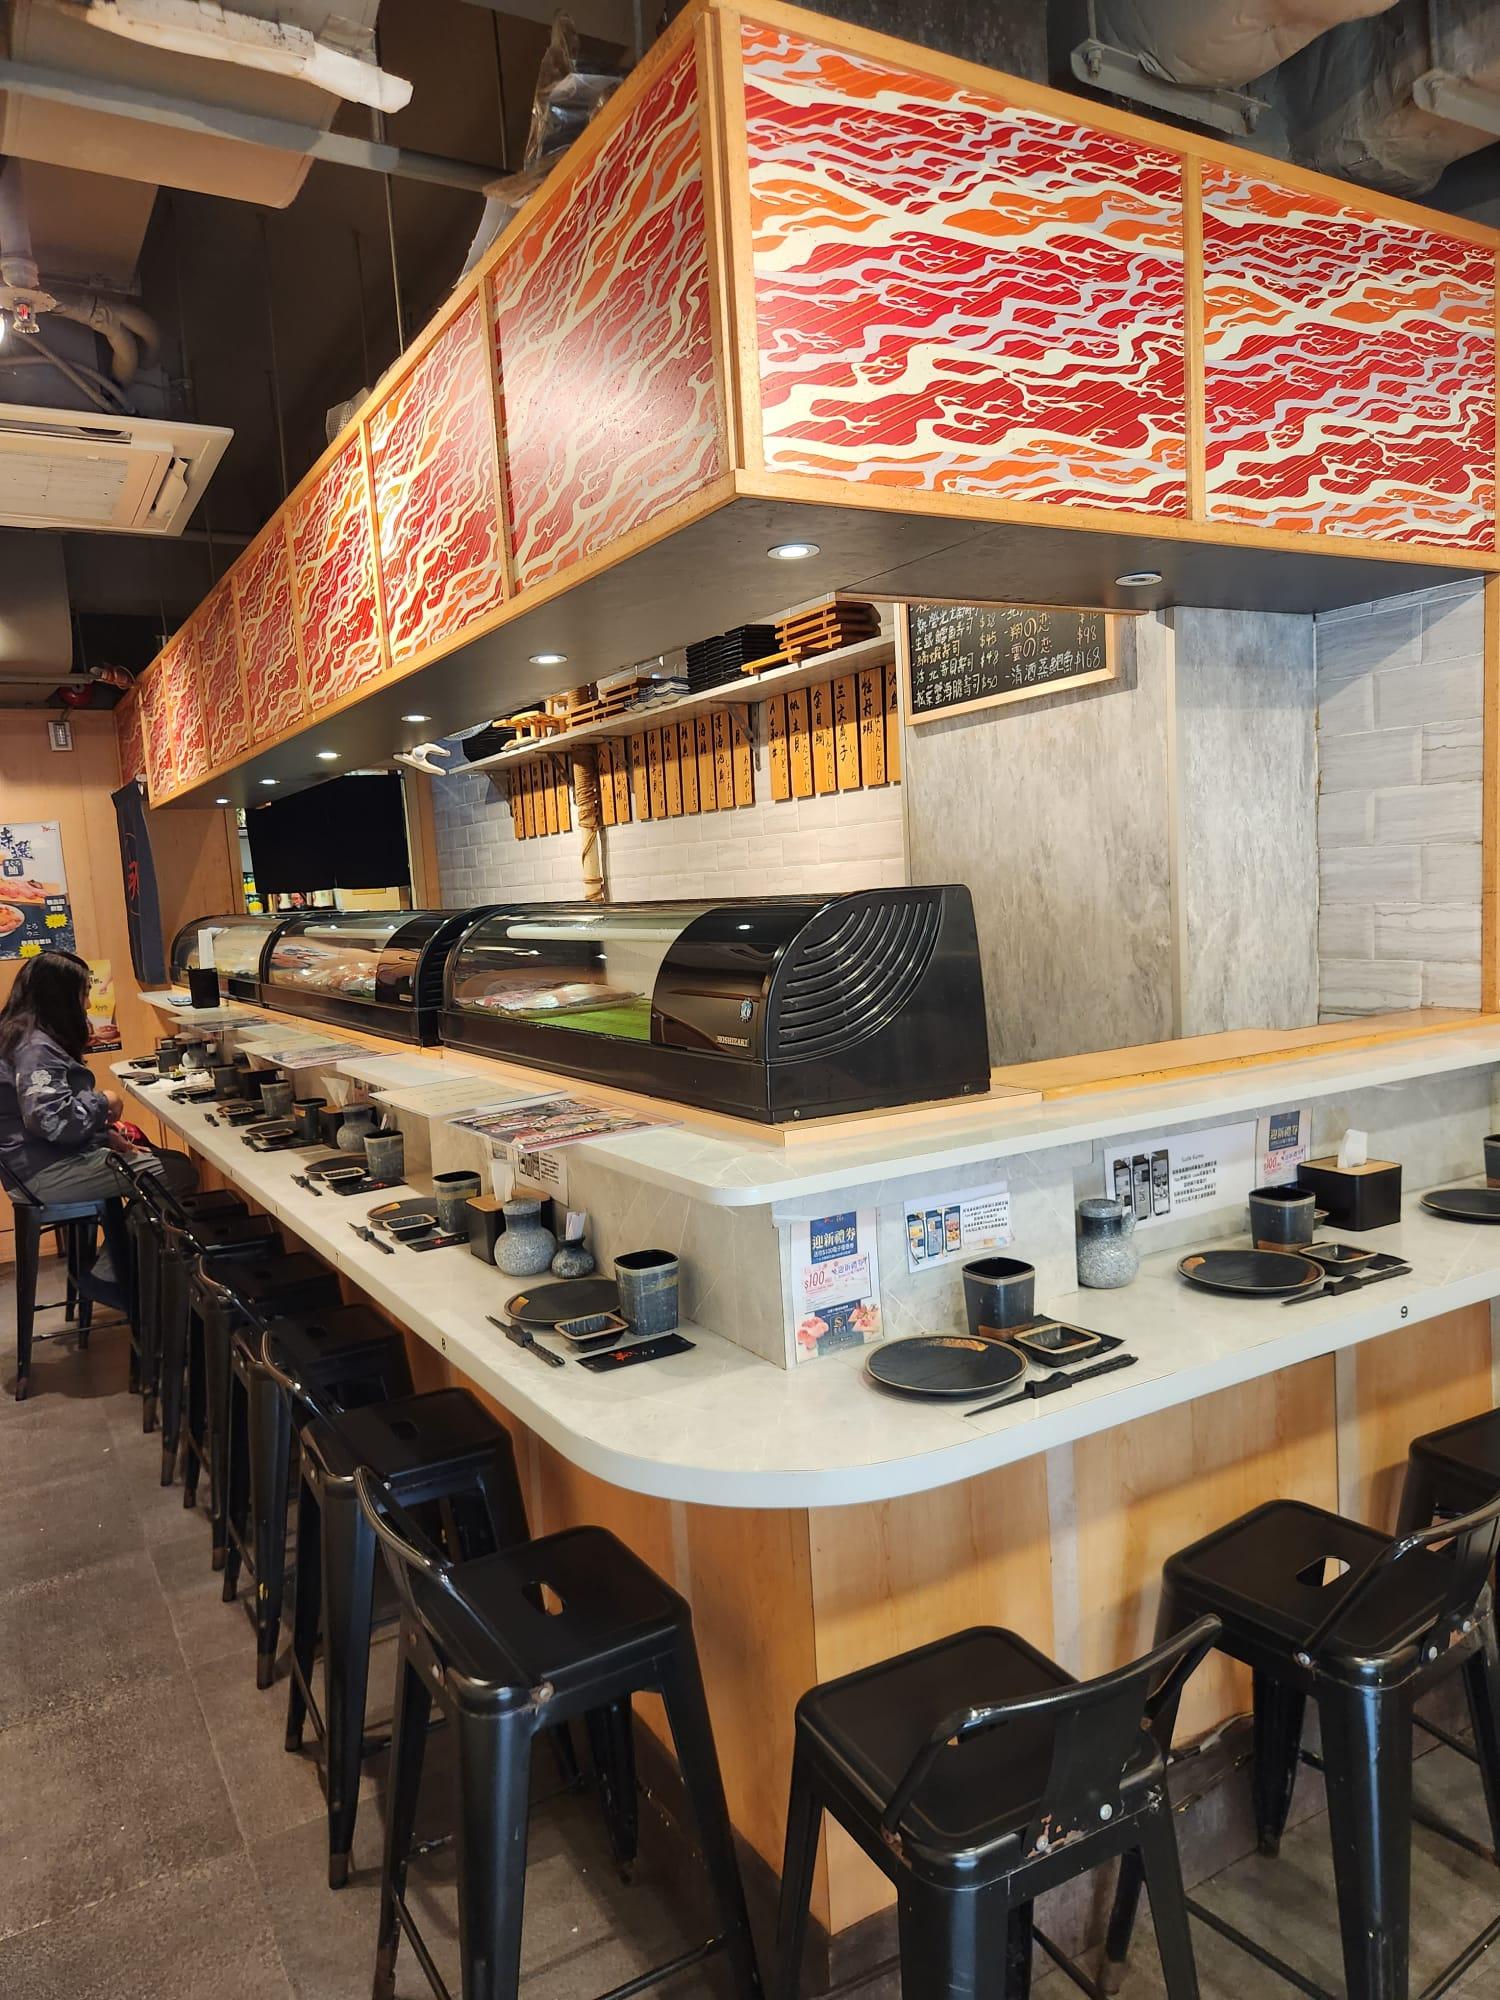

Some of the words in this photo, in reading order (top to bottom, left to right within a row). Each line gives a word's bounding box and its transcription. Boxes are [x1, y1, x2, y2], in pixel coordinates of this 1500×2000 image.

[1077, 624, 1097, 646] $98
[1074, 646, 1101, 673] $168
[981, 673, 998, 692] $50
[849, 743, 857, 781] いくら
[812, 1227, 856, 1250] 迎新禮券
[804, 1270, 825, 1291] $100
[1400, 1305, 1408, 1319] 9
[441, 1336, 447, 1351] 8
